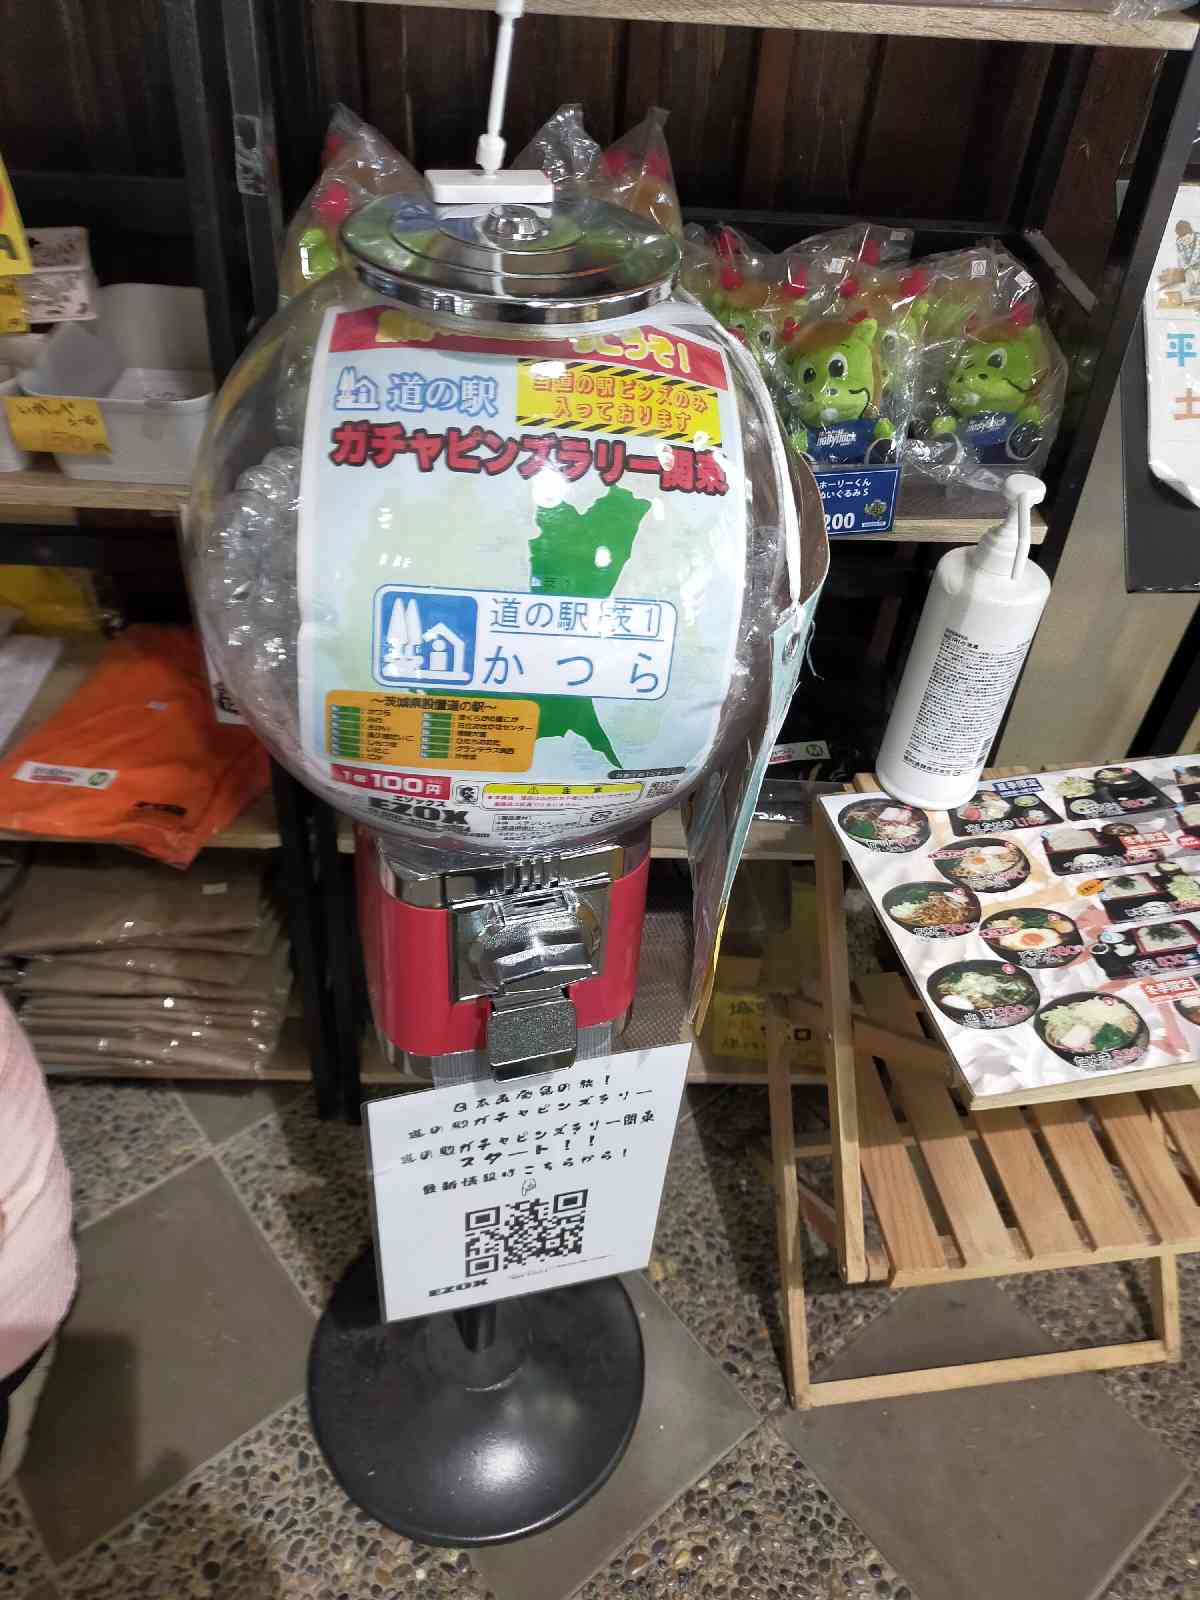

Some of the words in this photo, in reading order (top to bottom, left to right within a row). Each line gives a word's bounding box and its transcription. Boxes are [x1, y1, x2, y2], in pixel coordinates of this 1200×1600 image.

[388, 372, 499, 417] 道の駅
[554, 395, 692, 433] 入っております
[490, 598, 590, 633] 道の駅
[482, 646, 660, 694] かつら
